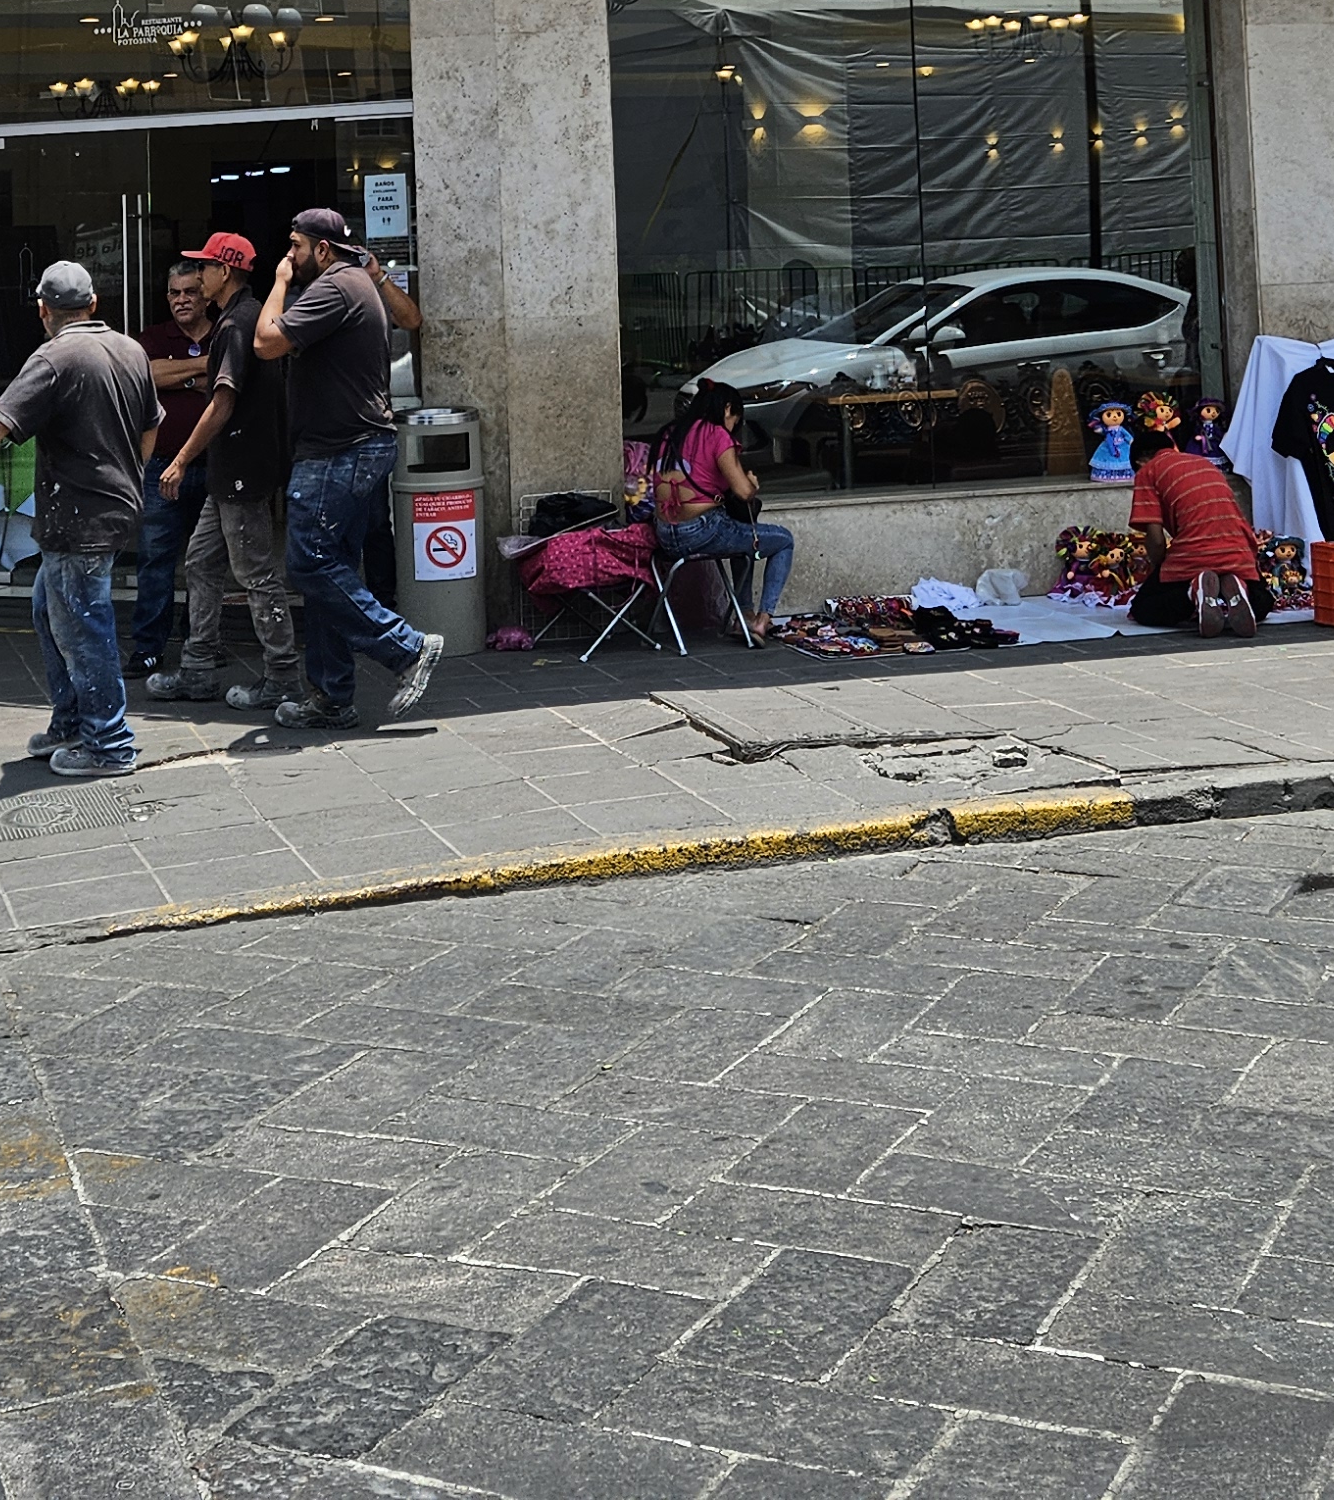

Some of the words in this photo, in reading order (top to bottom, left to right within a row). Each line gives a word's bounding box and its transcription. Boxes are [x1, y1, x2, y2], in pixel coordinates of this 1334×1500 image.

[141, 16, 183, 26] RESTAURANTE
[117, 28, 129, 39] LA
[117, 37, 157, 46] POTOSINA
